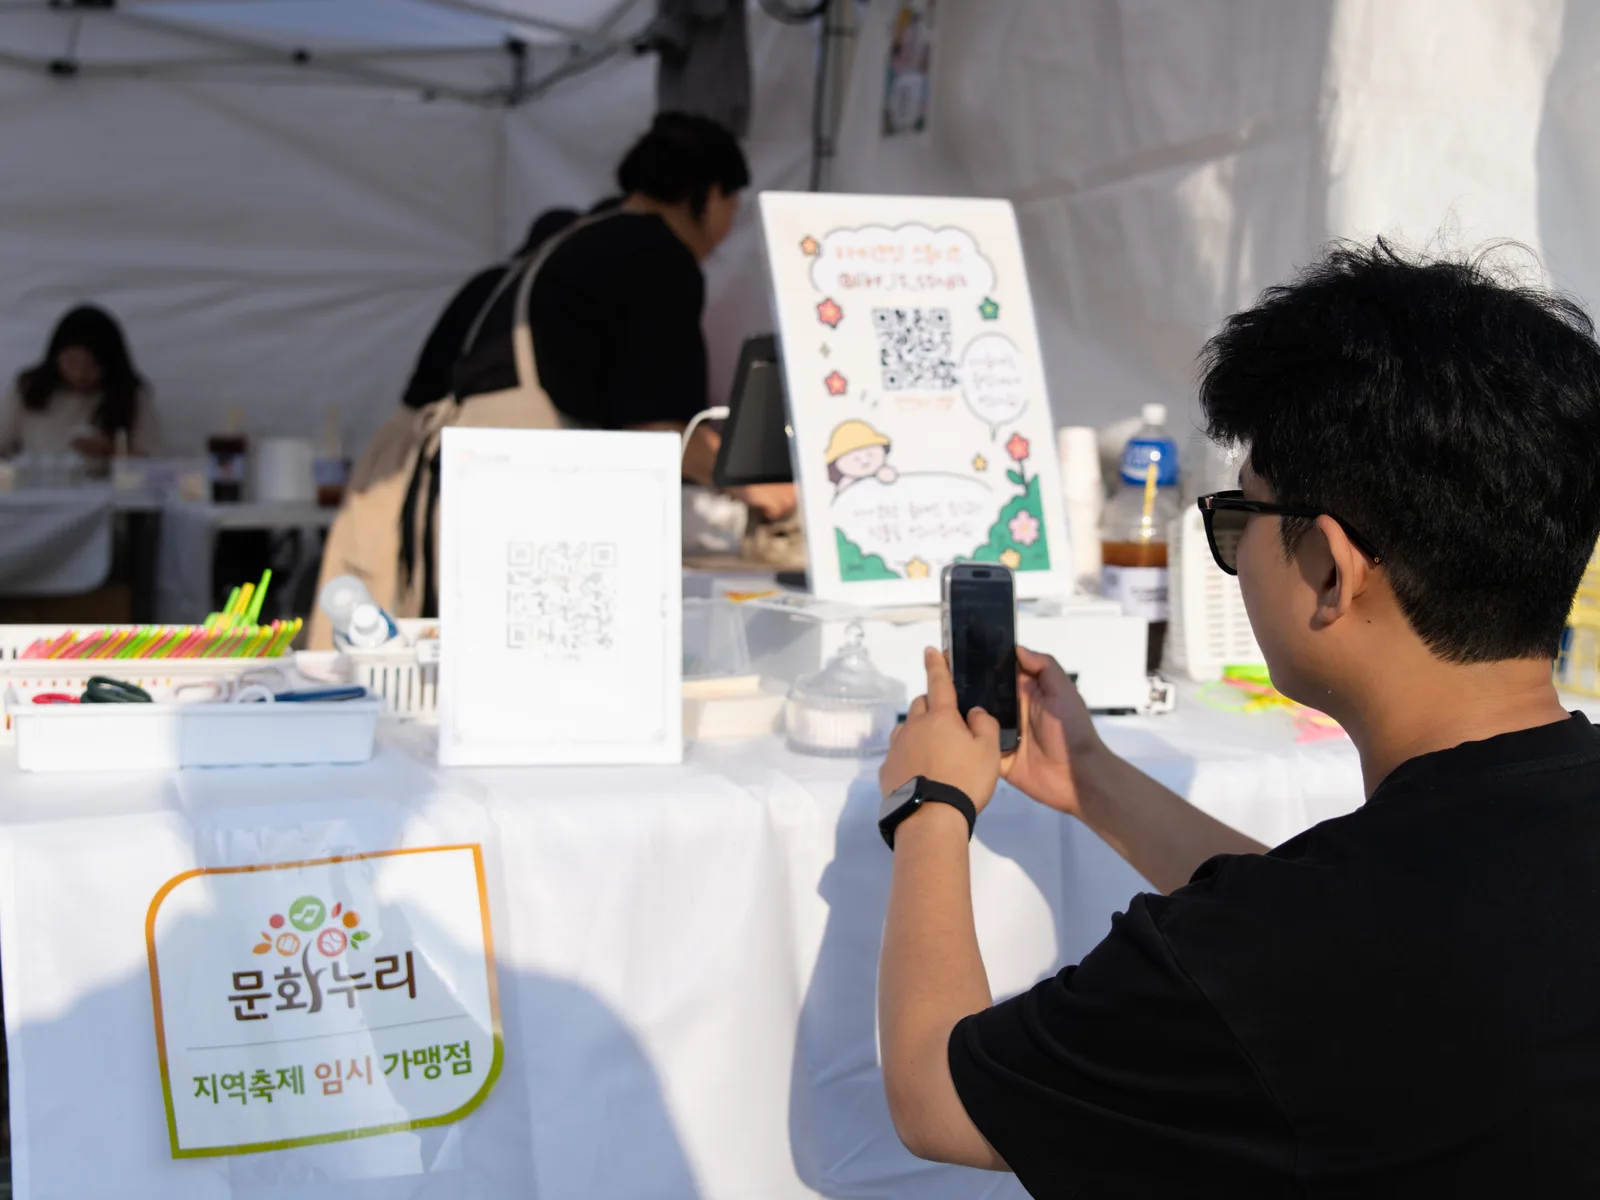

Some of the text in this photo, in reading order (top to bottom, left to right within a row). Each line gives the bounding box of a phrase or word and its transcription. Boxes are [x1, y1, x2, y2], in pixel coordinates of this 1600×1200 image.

[228, 940, 417, 1021] 문화누리
[193, 1040, 473, 1105] 지역축제 임시 가맹점
